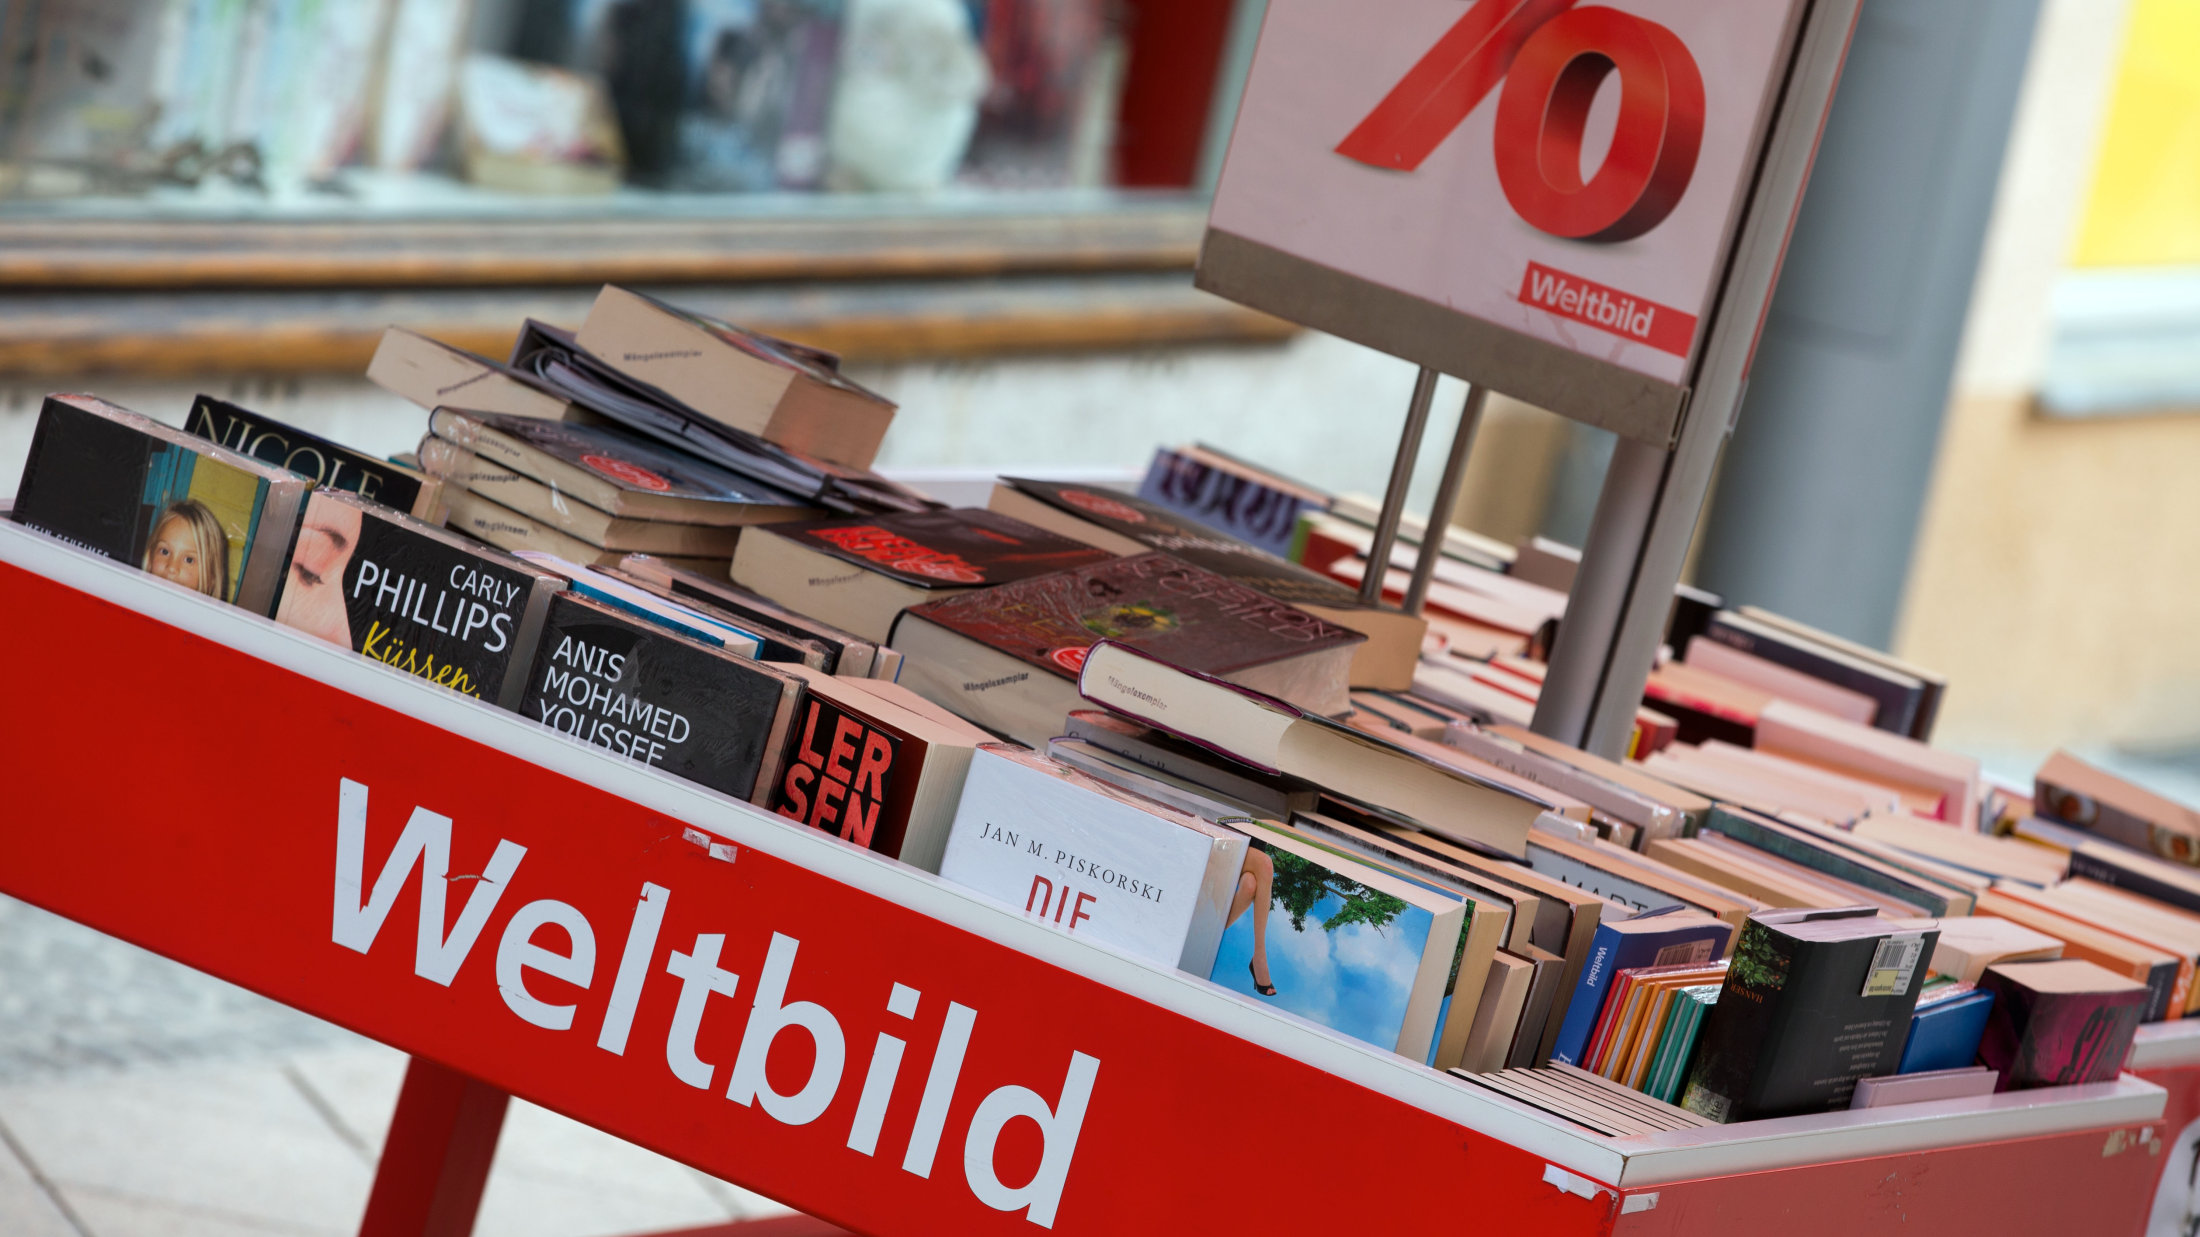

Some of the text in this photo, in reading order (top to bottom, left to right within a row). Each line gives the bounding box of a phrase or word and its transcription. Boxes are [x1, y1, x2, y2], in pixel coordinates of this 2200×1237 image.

[1531, 270, 1655, 338] Weltbild
[353, 560, 511, 652] PHILLIPS
[450, 565, 520, 608] CARLY
[552, 635, 626, 683] ANIS
[963, 672, 1030, 692] Mängelexemplar
[543, 665, 690, 744] MOHAMED
[1107, 675, 1168, 711] Mängelexemplar
[540, 699, 666, 765] YOUSSEF
[798, 700, 893, 803] LER
[775, 763, 881, 850] SEN
[980, 822, 1164, 904] JAN M. PISKORSKI
[1025, 874, 1098, 930] DIE
[1586, 946, 1608, 987] Weltbild
[1730, 982, 1764, 1004] HANSER
[332, 776, 1101, 1230] Weltbild
